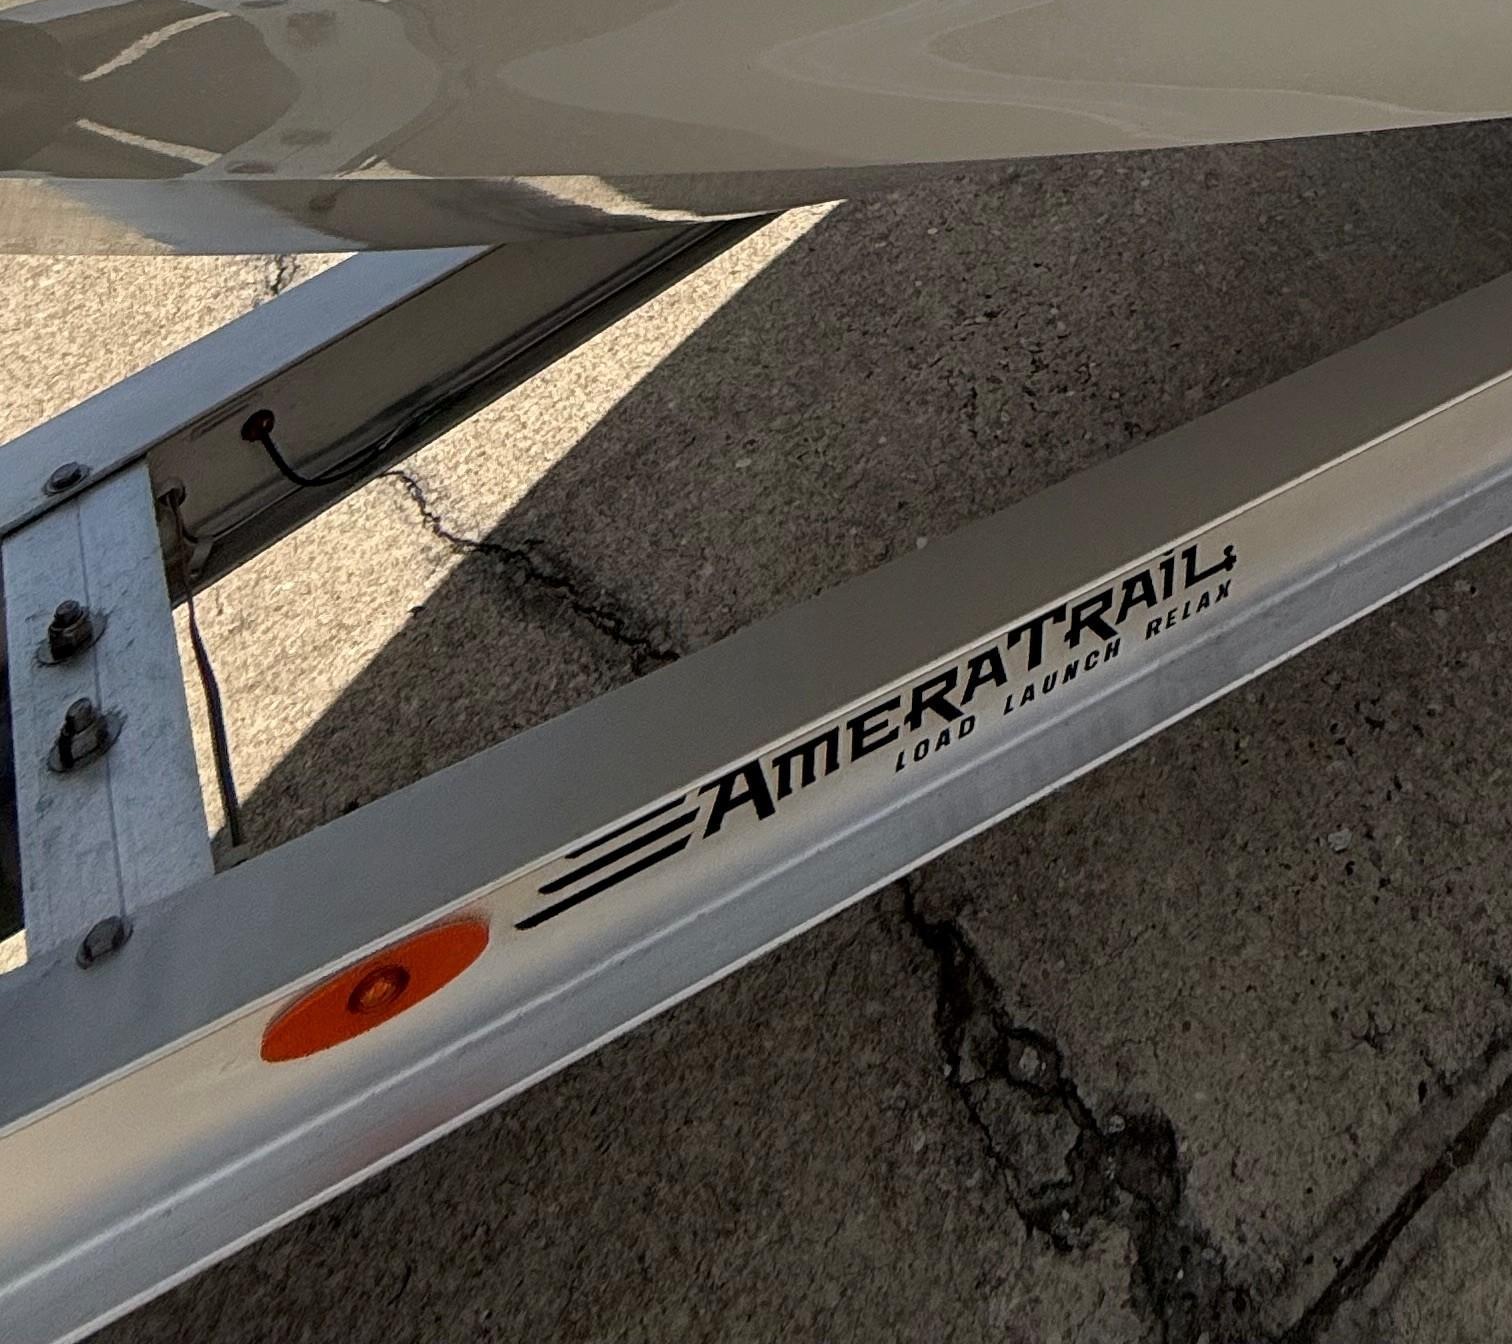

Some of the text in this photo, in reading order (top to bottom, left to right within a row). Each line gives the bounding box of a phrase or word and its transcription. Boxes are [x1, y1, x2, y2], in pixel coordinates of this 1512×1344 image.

[895, 579, 1233, 773] LOAD LAUNCH RELAX
